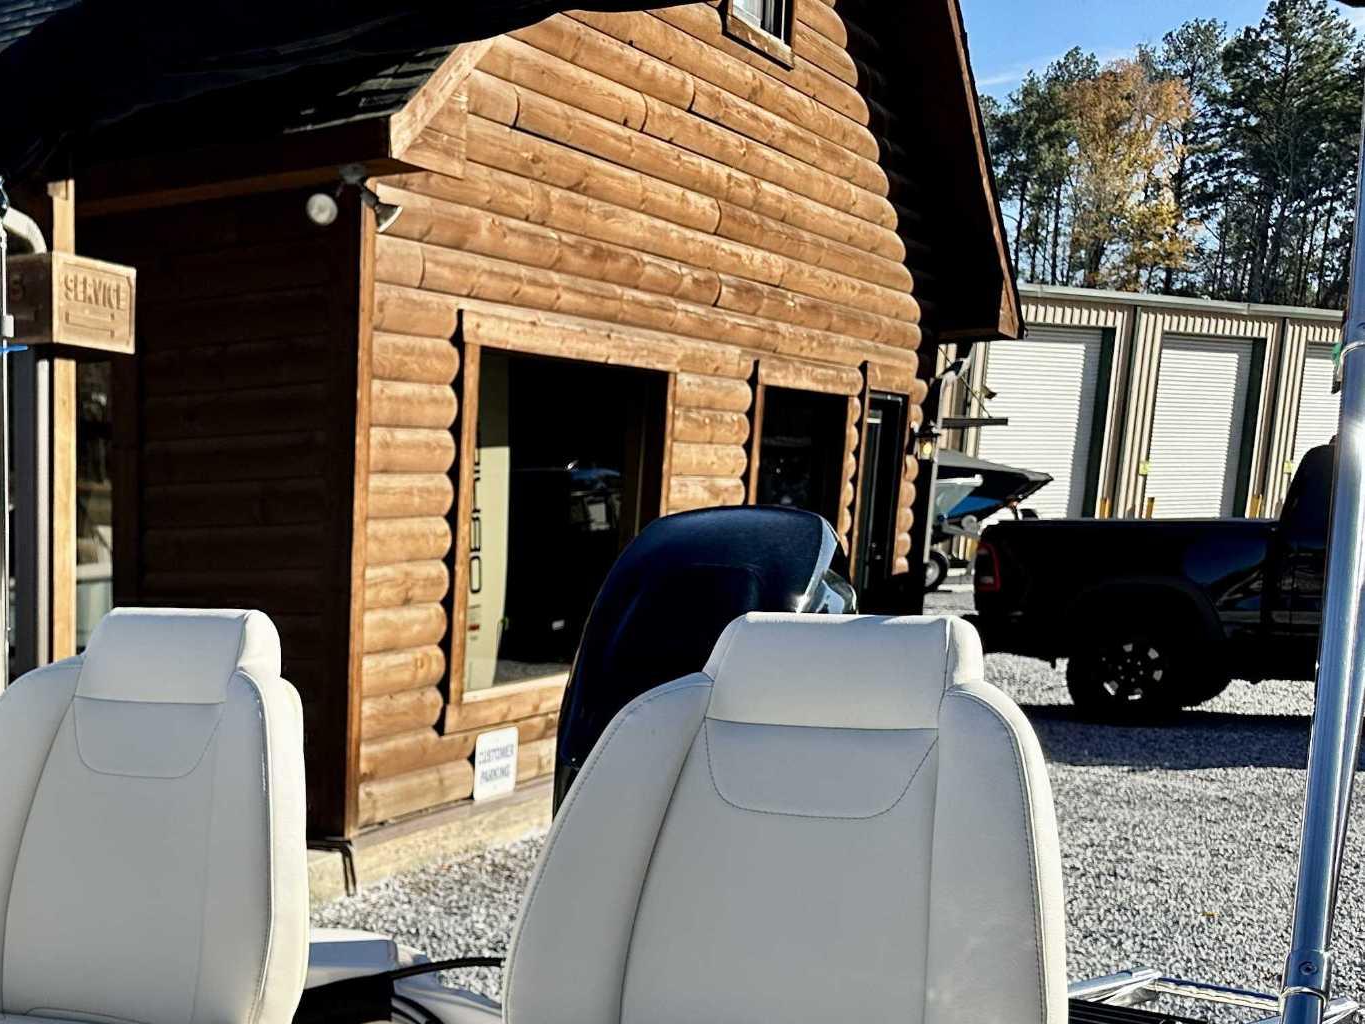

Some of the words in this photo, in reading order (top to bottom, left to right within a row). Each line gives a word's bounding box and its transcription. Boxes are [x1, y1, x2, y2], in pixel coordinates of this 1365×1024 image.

[63, 273, 127, 312] SERVICE
[478, 743, 515, 766] CUSTOMER
[479, 763, 510, 785] PARKING
